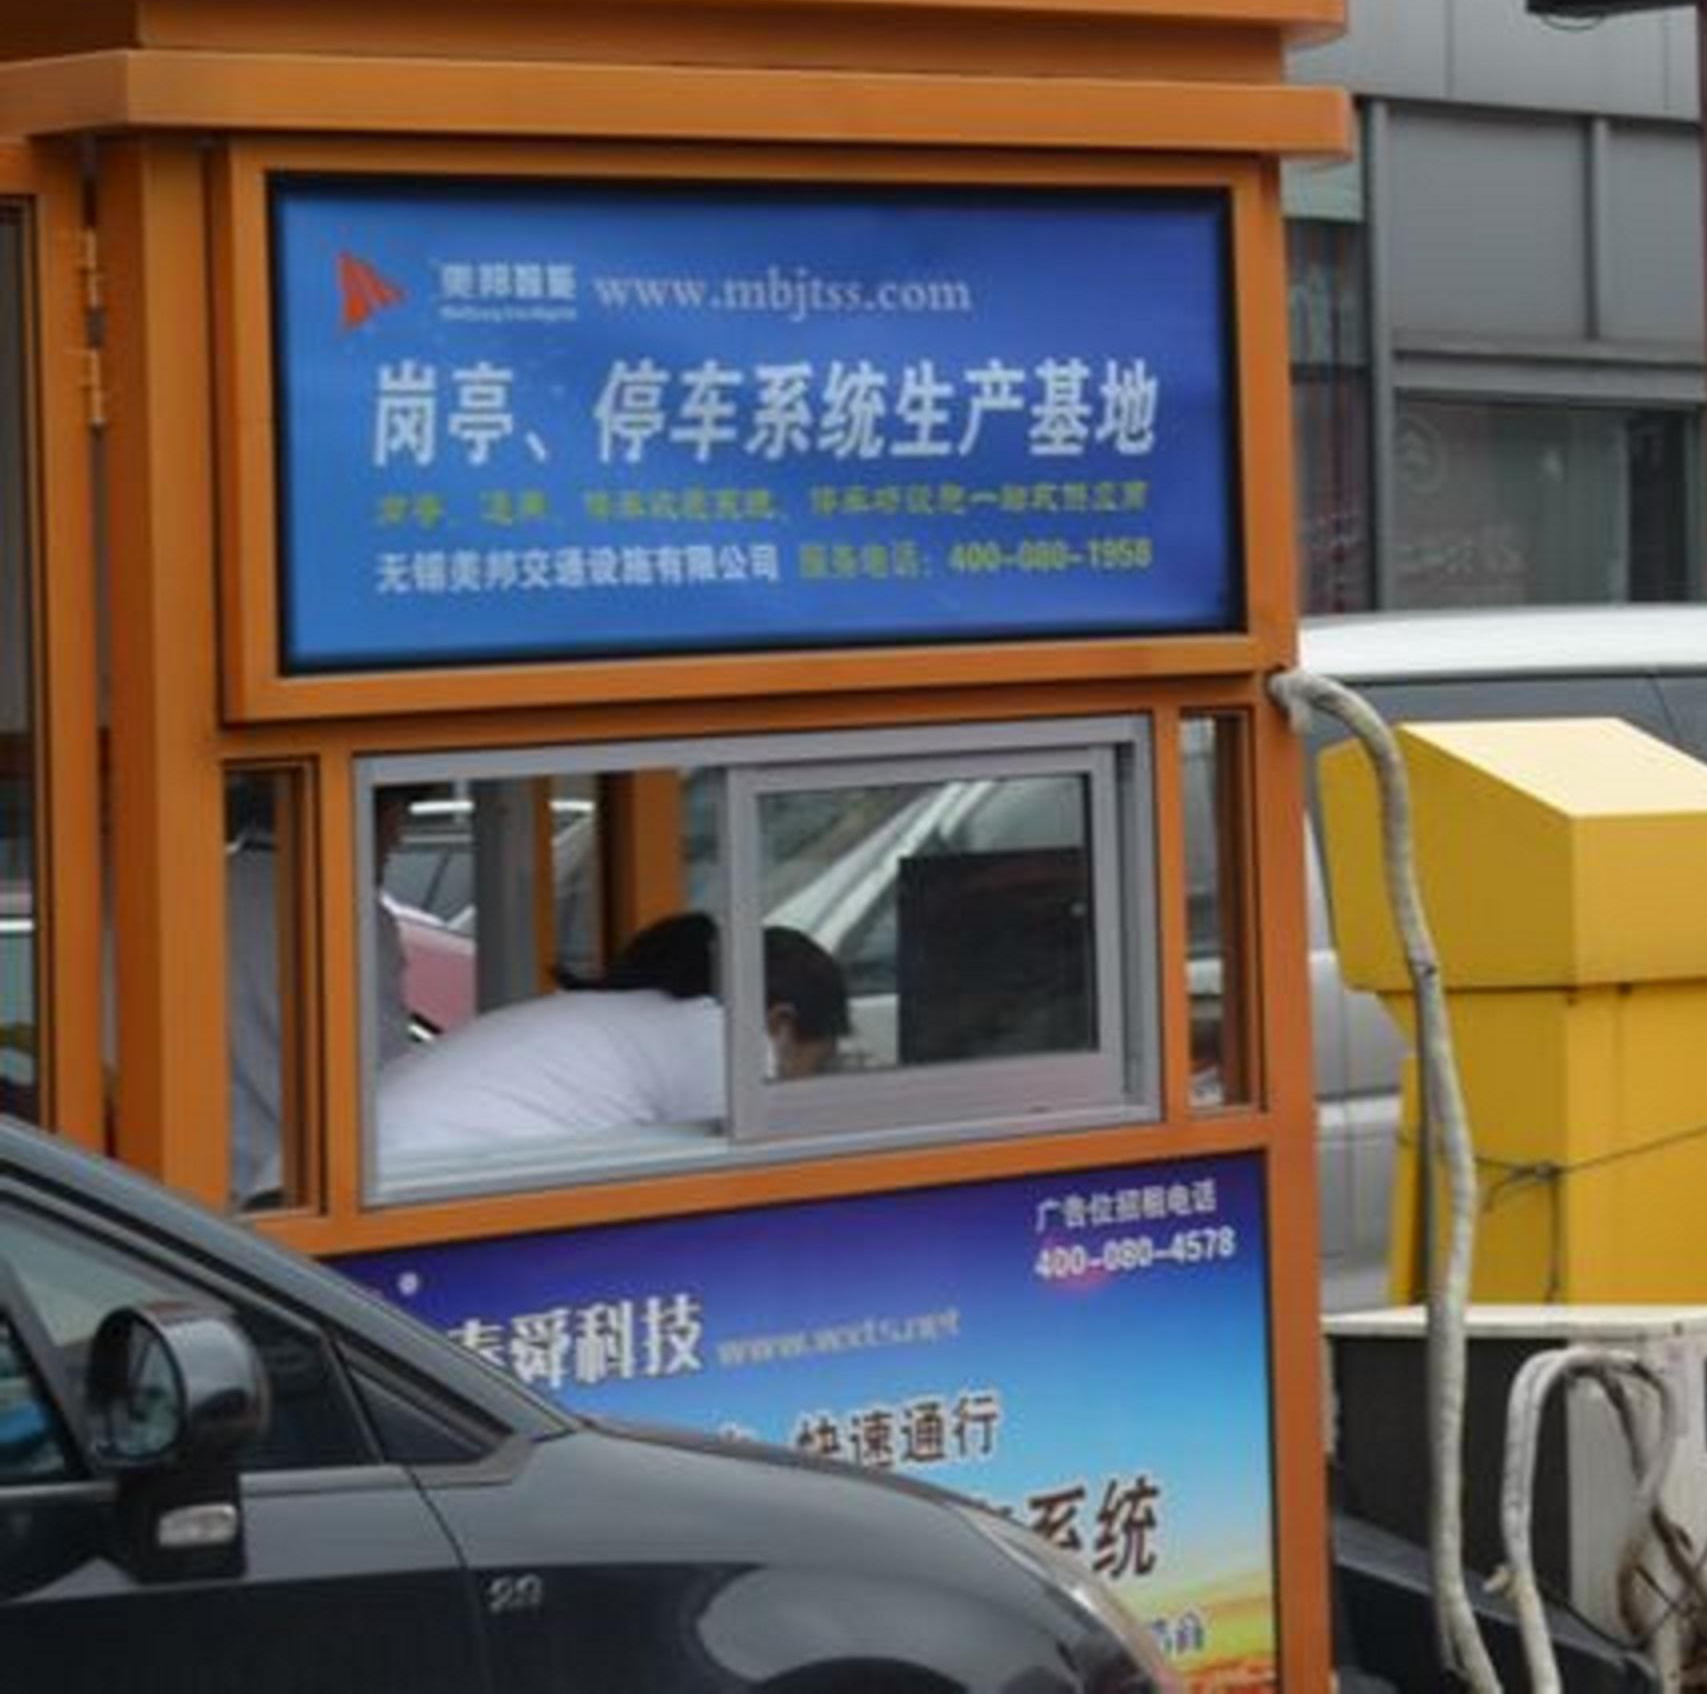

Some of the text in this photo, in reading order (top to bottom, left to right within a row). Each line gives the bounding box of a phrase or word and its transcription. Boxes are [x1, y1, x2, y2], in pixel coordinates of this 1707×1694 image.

[374, 358, 1160, 467] 岗亭、停车系统生产基地
[1034, 1177, 1218, 1235] 广告位招租电话
[1033, 1225, 1236, 1283] 400-080-4578
